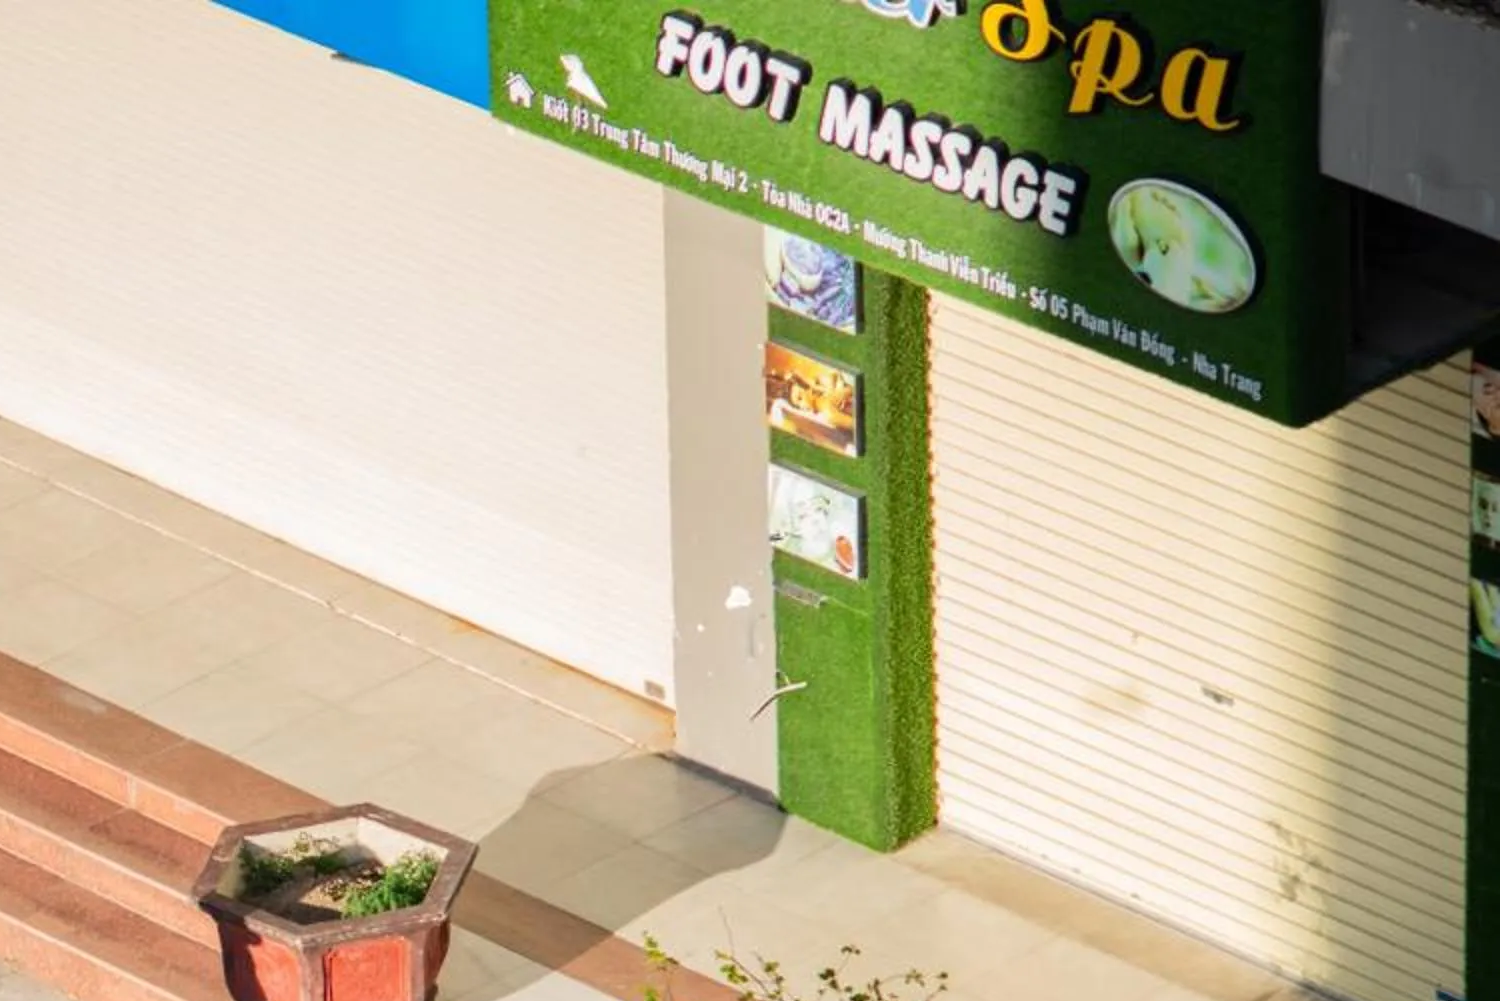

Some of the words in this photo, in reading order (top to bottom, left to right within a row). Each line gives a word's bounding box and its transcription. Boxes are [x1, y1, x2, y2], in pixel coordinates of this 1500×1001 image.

[656, 12, 808, 122] FOOT
[819, 82, 1080, 237] MASSAGE
[592, 113, 629, 150] Trung
[738, 170, 749, 193] 2
[815, 202, 850, 235] OC2A
[908, 237, 949, 273] Thanh
[1051, 293, 1069, 320] 05
[1193, 351, 1217, 381] Nha
[1221, 363, 1263, 402] Trang
